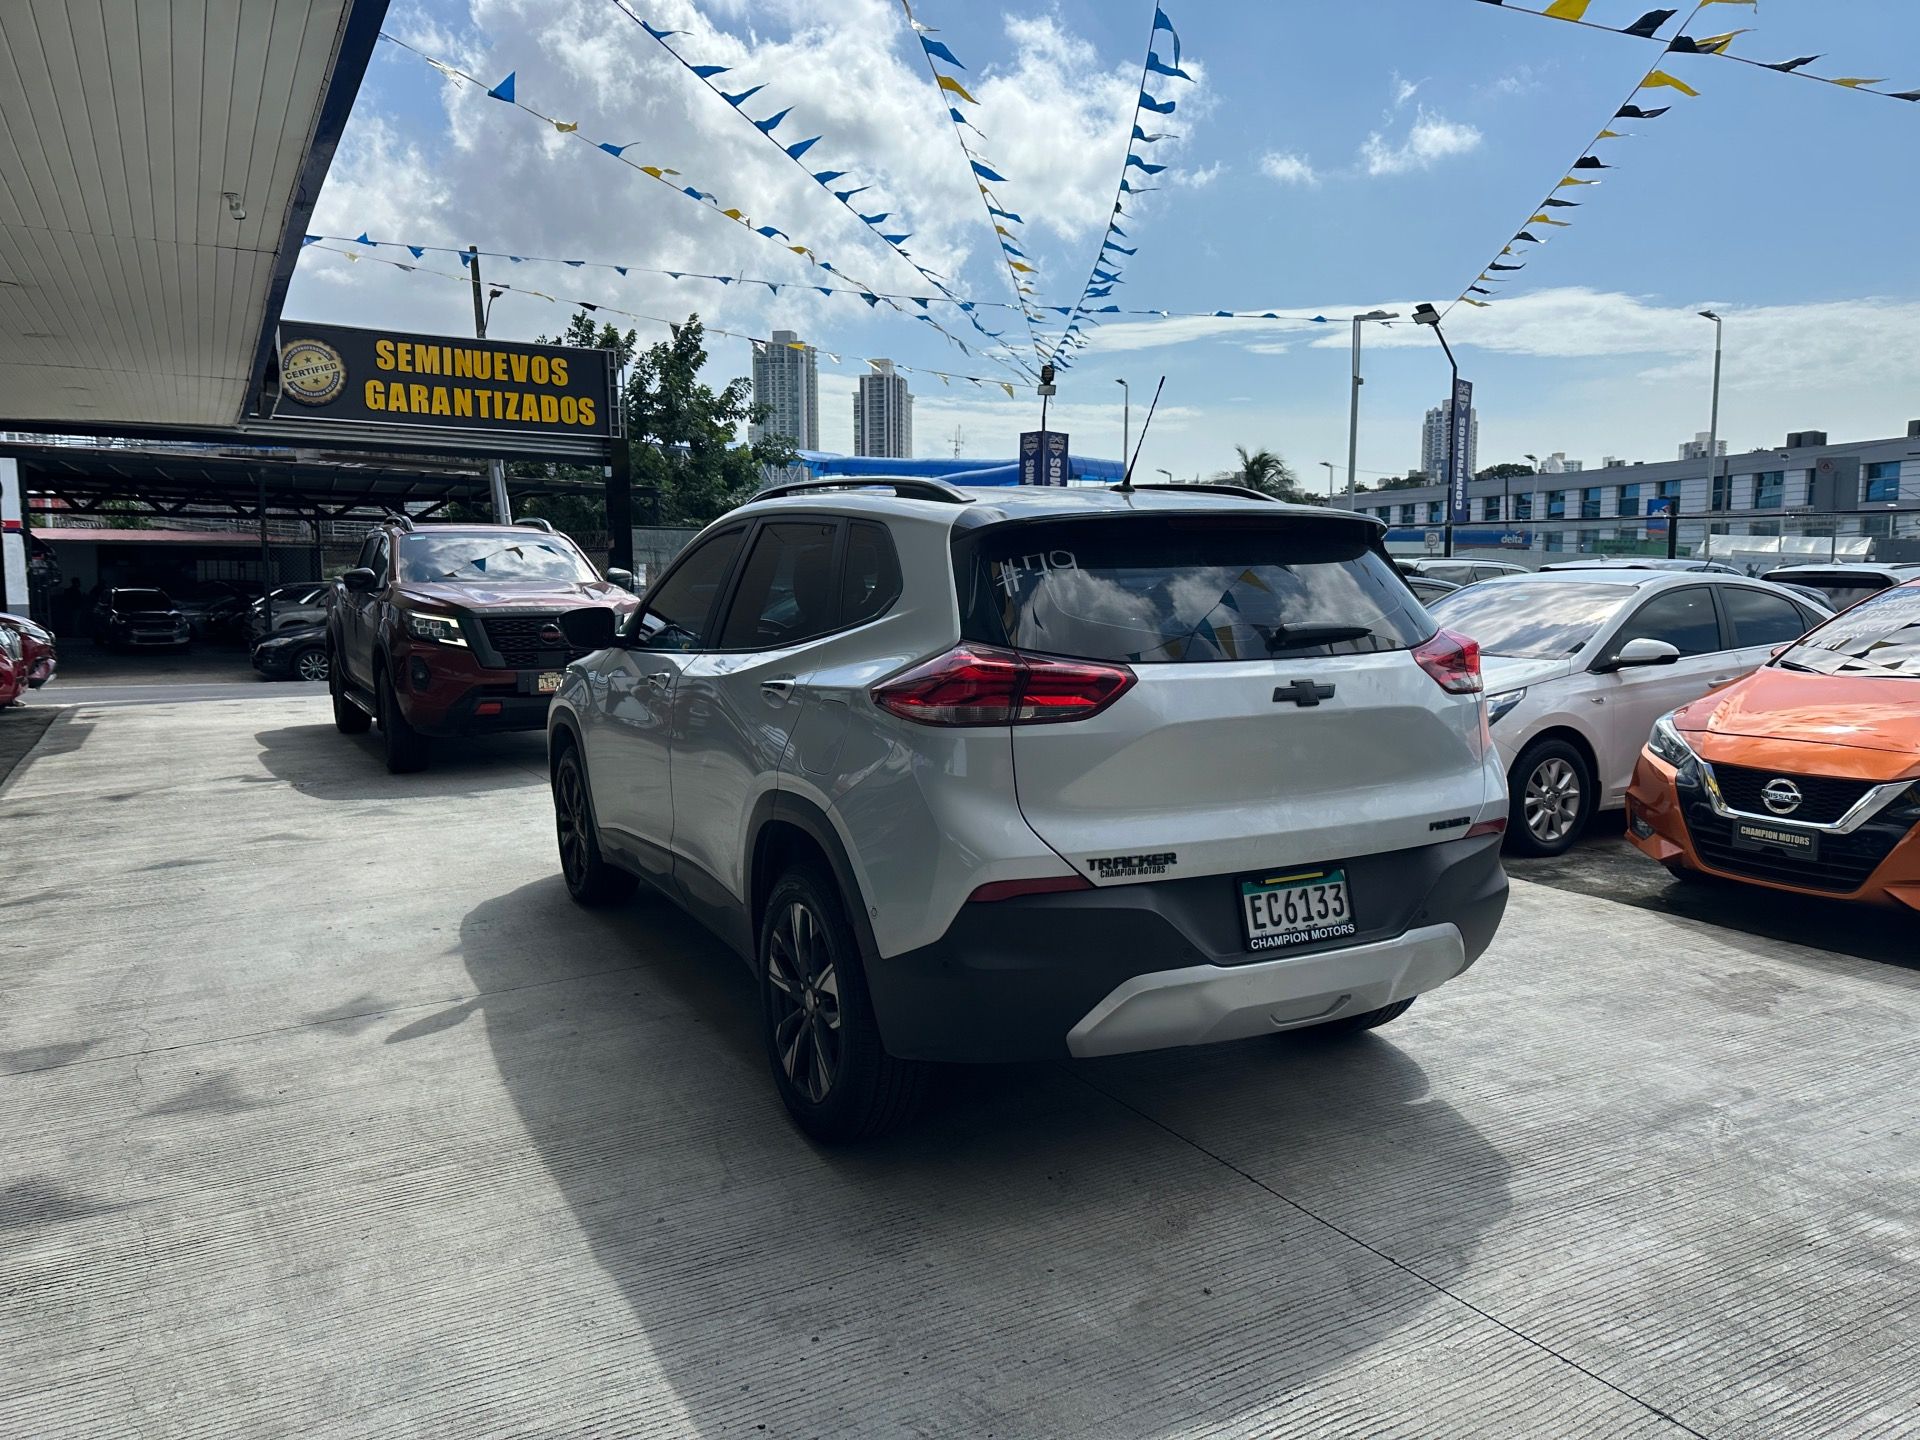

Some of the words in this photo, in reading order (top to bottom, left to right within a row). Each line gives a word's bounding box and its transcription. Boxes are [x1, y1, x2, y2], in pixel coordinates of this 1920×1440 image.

[285, 362, 337, 380] CERTIFIED
[375, 339, 569, 387] SEMINUEVOS
[364, 379, 597, 426] GARANTIZADOS
[1455, 417, 1466, 510] COMPRAMOS
[1501, 534, 1523, 544] delta
[1762, 790, 1800, 802] NISSAN
[1429, 816, 1471, 831] PREMIER
[1740, 826, 1778, 840] CHAMPION
[1778, 833, 1810, 845] MOTORS
[1086, 852, 1178, 871] TRACKER
[1100, 867, 1137, 879] CHAMPION
[1137, 864, 1167, 876] MOTORS
[1249, 883, 1345, 930] EC6133
[1250, 931, 1309, 950] CHAMPION
[1311, 923, 1356, 940] MOTORS
